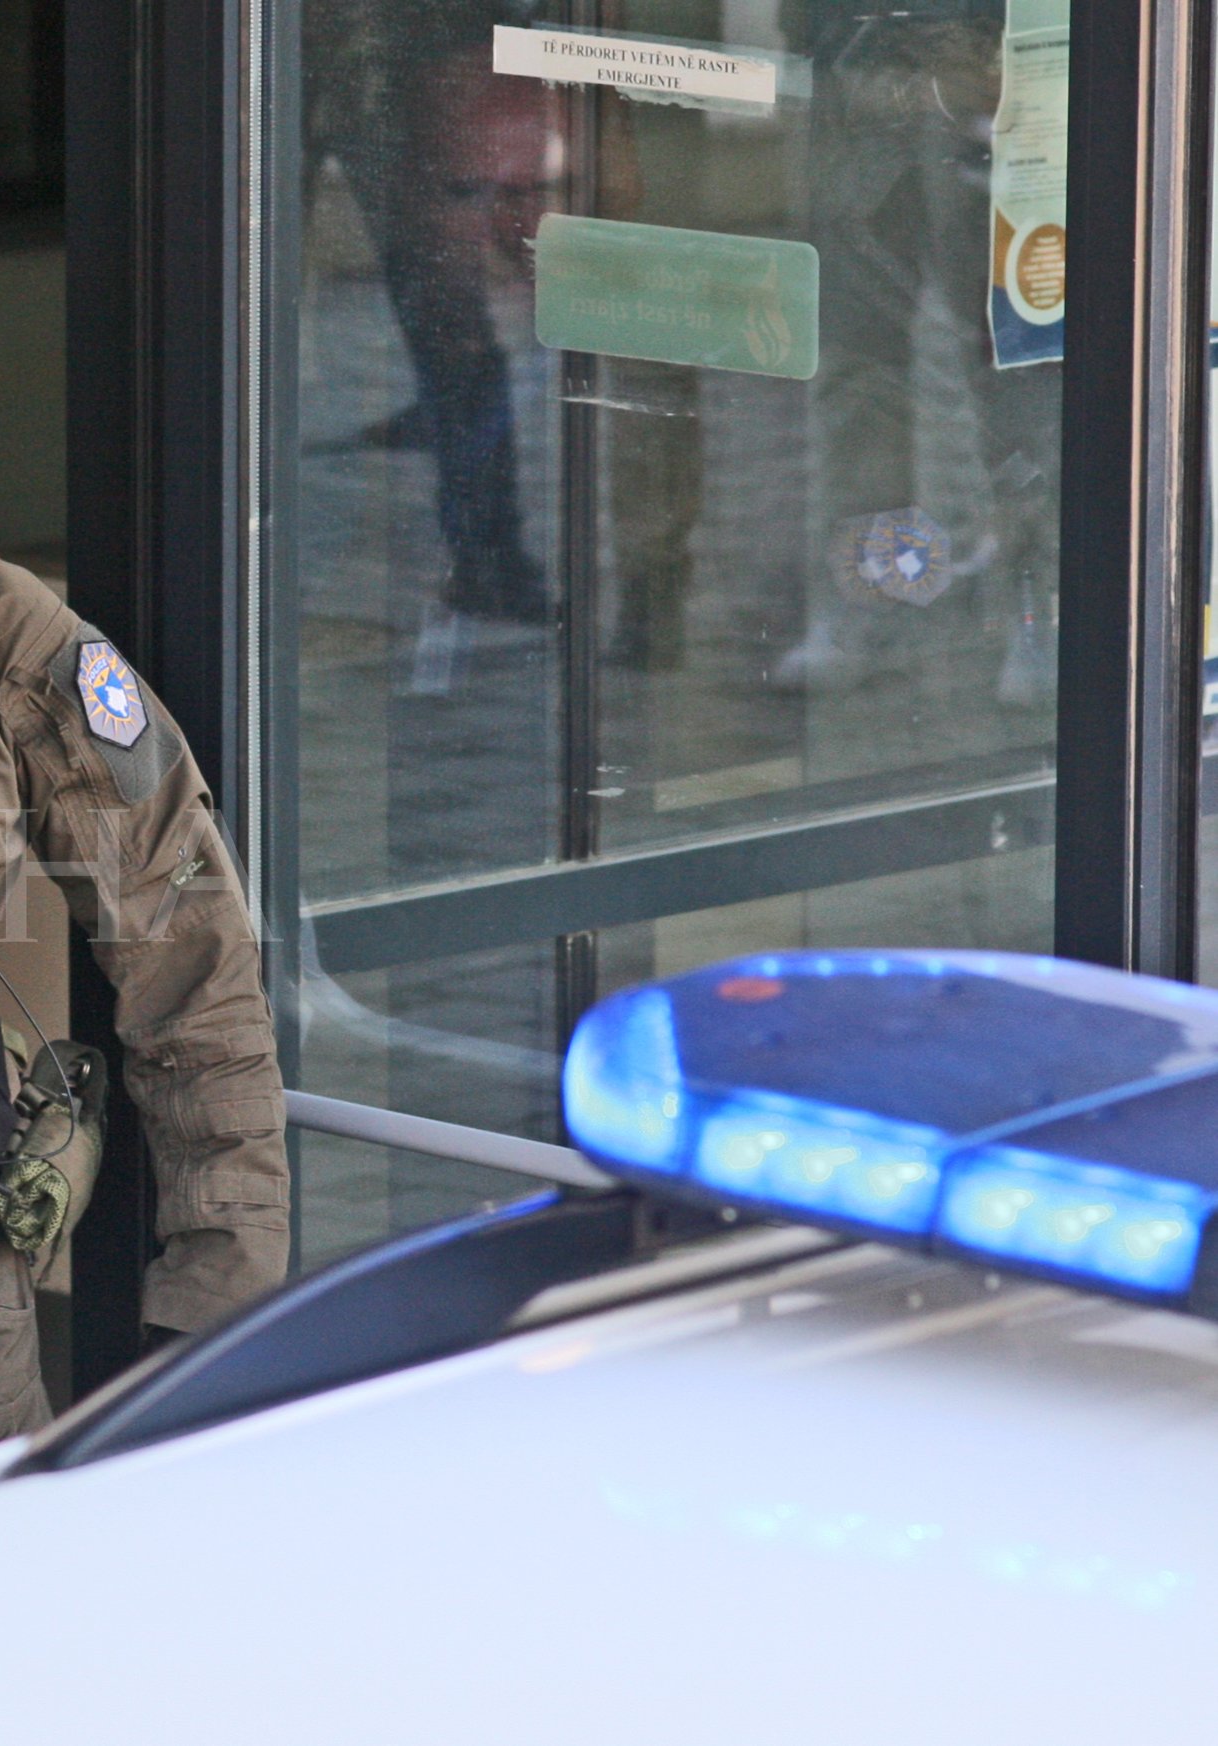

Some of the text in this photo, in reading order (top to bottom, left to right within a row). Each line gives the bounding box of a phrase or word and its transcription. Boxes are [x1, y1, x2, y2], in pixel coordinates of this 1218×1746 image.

[542, 39, 740, 75] TË PËRDORET VETËM NË RASTE
[597, 68, 682, 89] EMERGJENTE
